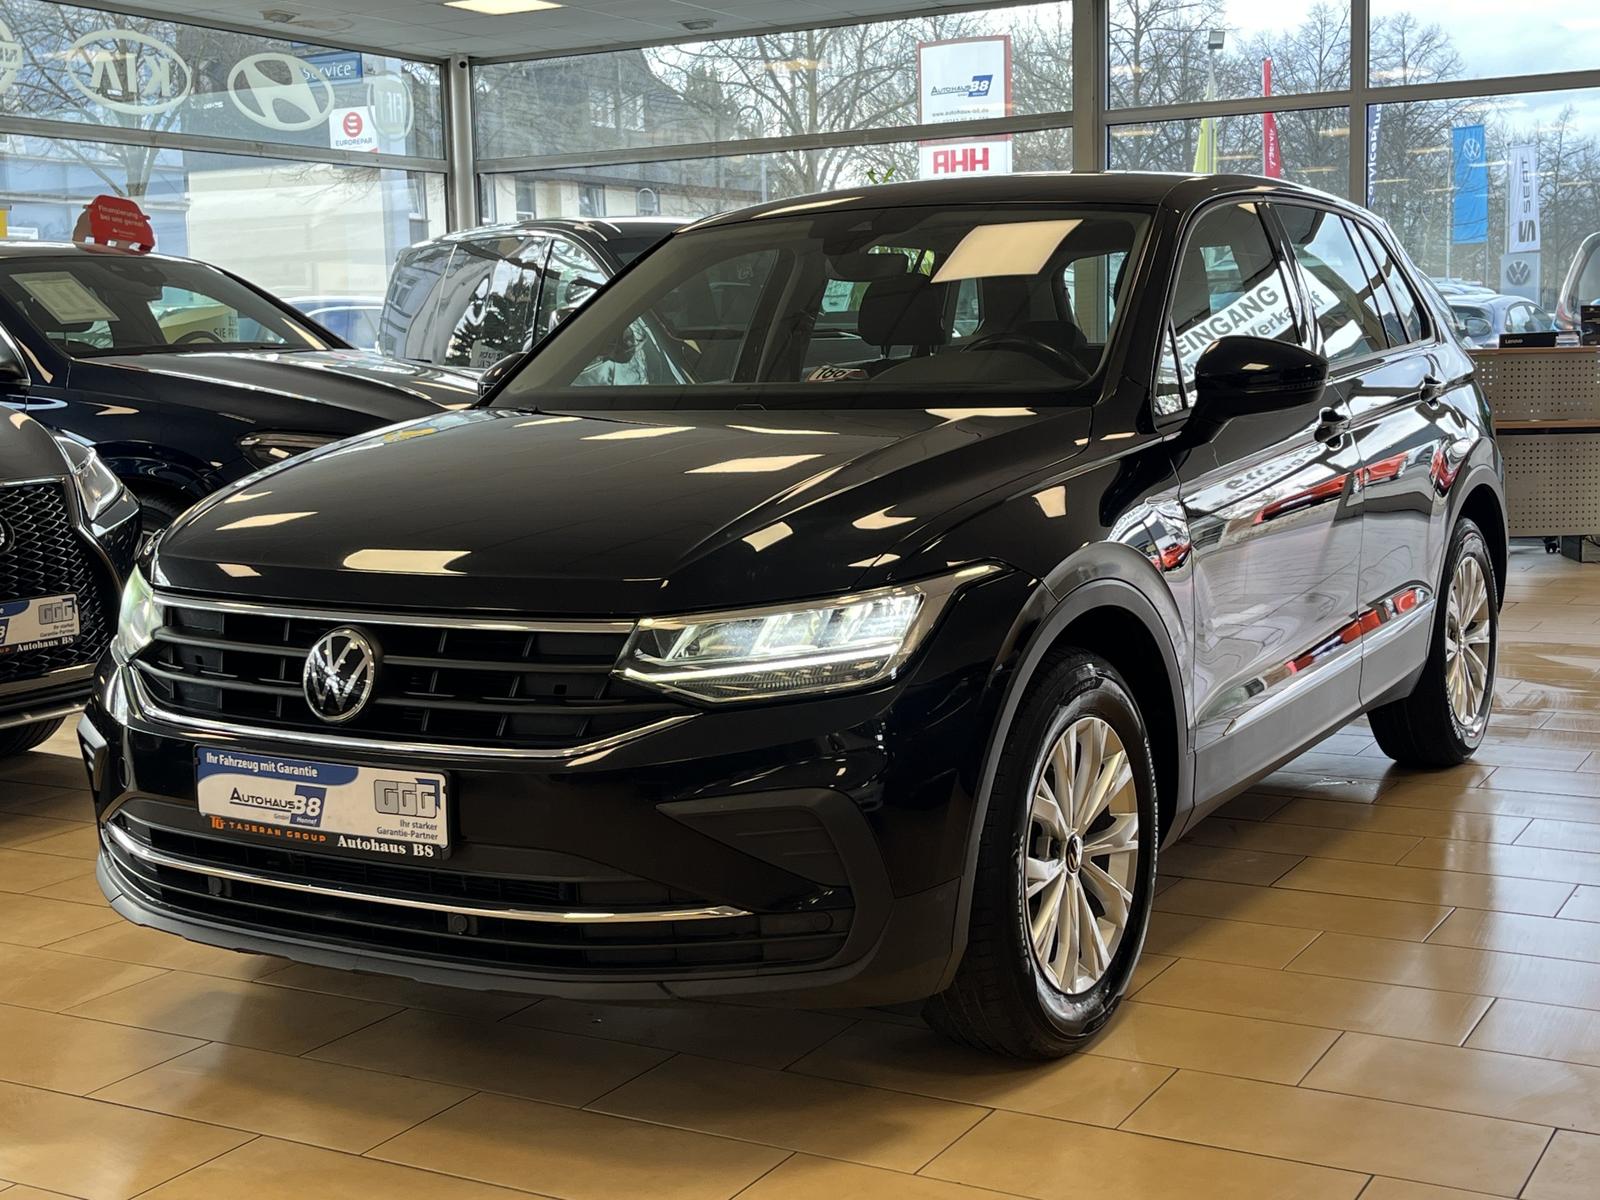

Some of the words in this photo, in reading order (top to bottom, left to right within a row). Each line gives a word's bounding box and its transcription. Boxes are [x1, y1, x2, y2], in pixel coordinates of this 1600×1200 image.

[933, 147, 990, 174] AHH
[1522, 159, 1531, 214] SEAT
[17, 639, 59, 652] Autohaus
[206, 752, 218, 764] Ihr
[219, 754, 259, 772] Fahrzeug
[260, 761, 275, 772] mit
[277, 763, 318, 777] Garantie
[376, 827, 438, 840] Garantie-Partner
[399, 820, 410, 828] Ihr
[411, 821, 438, 831] starker
[286, 831, 327, 842] GROUP
[337, 835, 407, 855] Autohaus
[413, 843, 434, 857] B8
